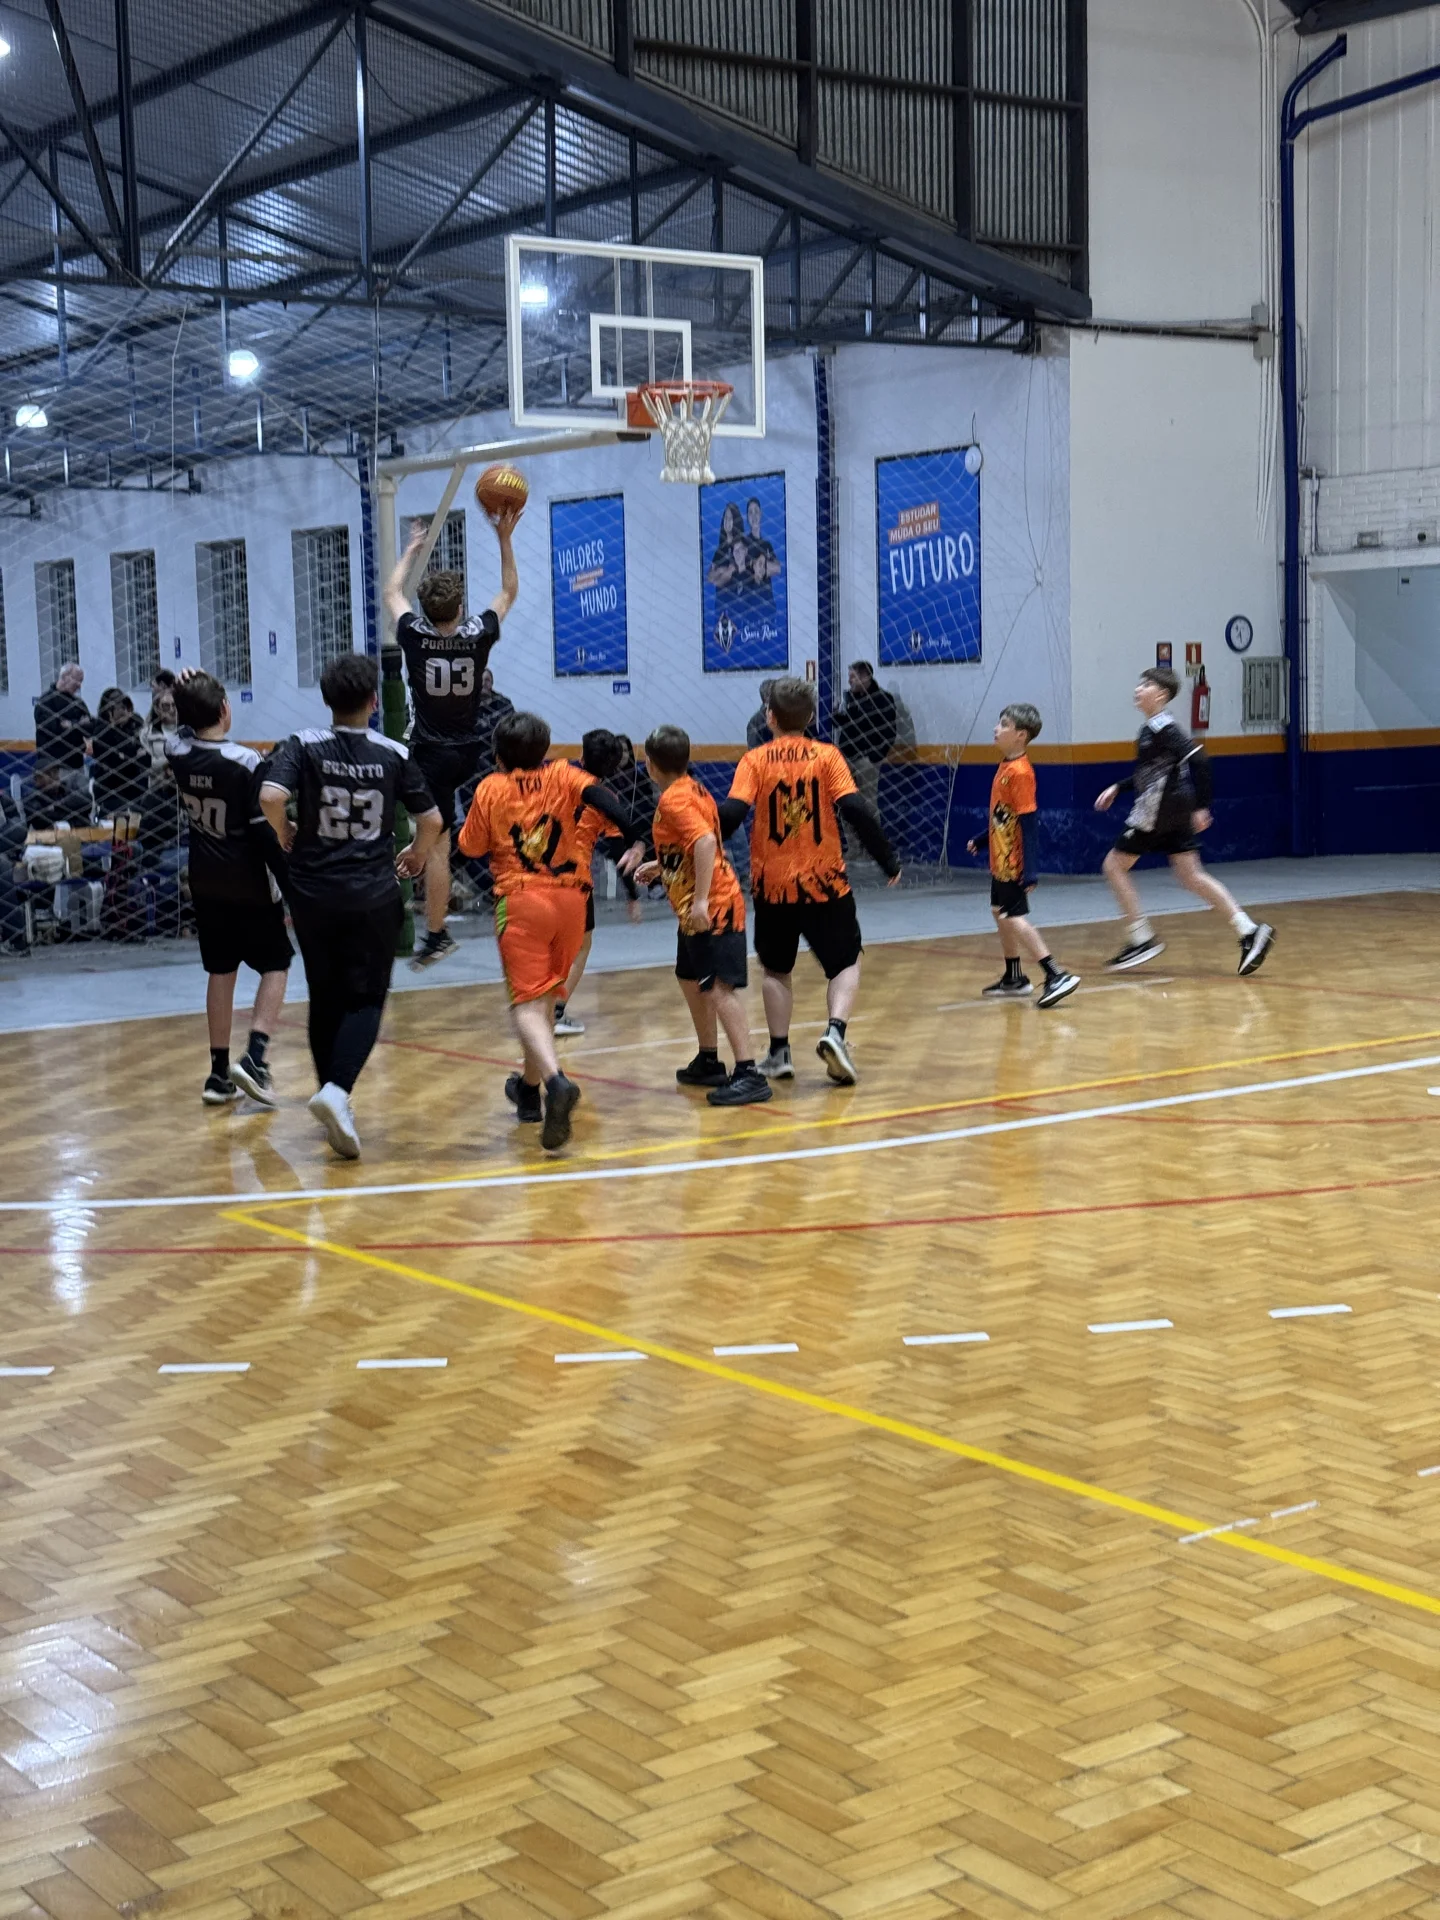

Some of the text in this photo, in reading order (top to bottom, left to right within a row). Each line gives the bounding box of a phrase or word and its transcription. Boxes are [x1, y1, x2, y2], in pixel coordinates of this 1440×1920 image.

[889, 518, 940, 544] MUDA O SEU
[900, 503, 937, 525] ESTUDAR
[557, 538, 605, 576] VALORES
[889, 531, 975, 595] FUTURO
[579, 584, 618, 618] MUNDO
[425, 657, 475, 697] 03
[766, 745, 818, 763] NICOLAS
[317, 785, 384, 841] 23
